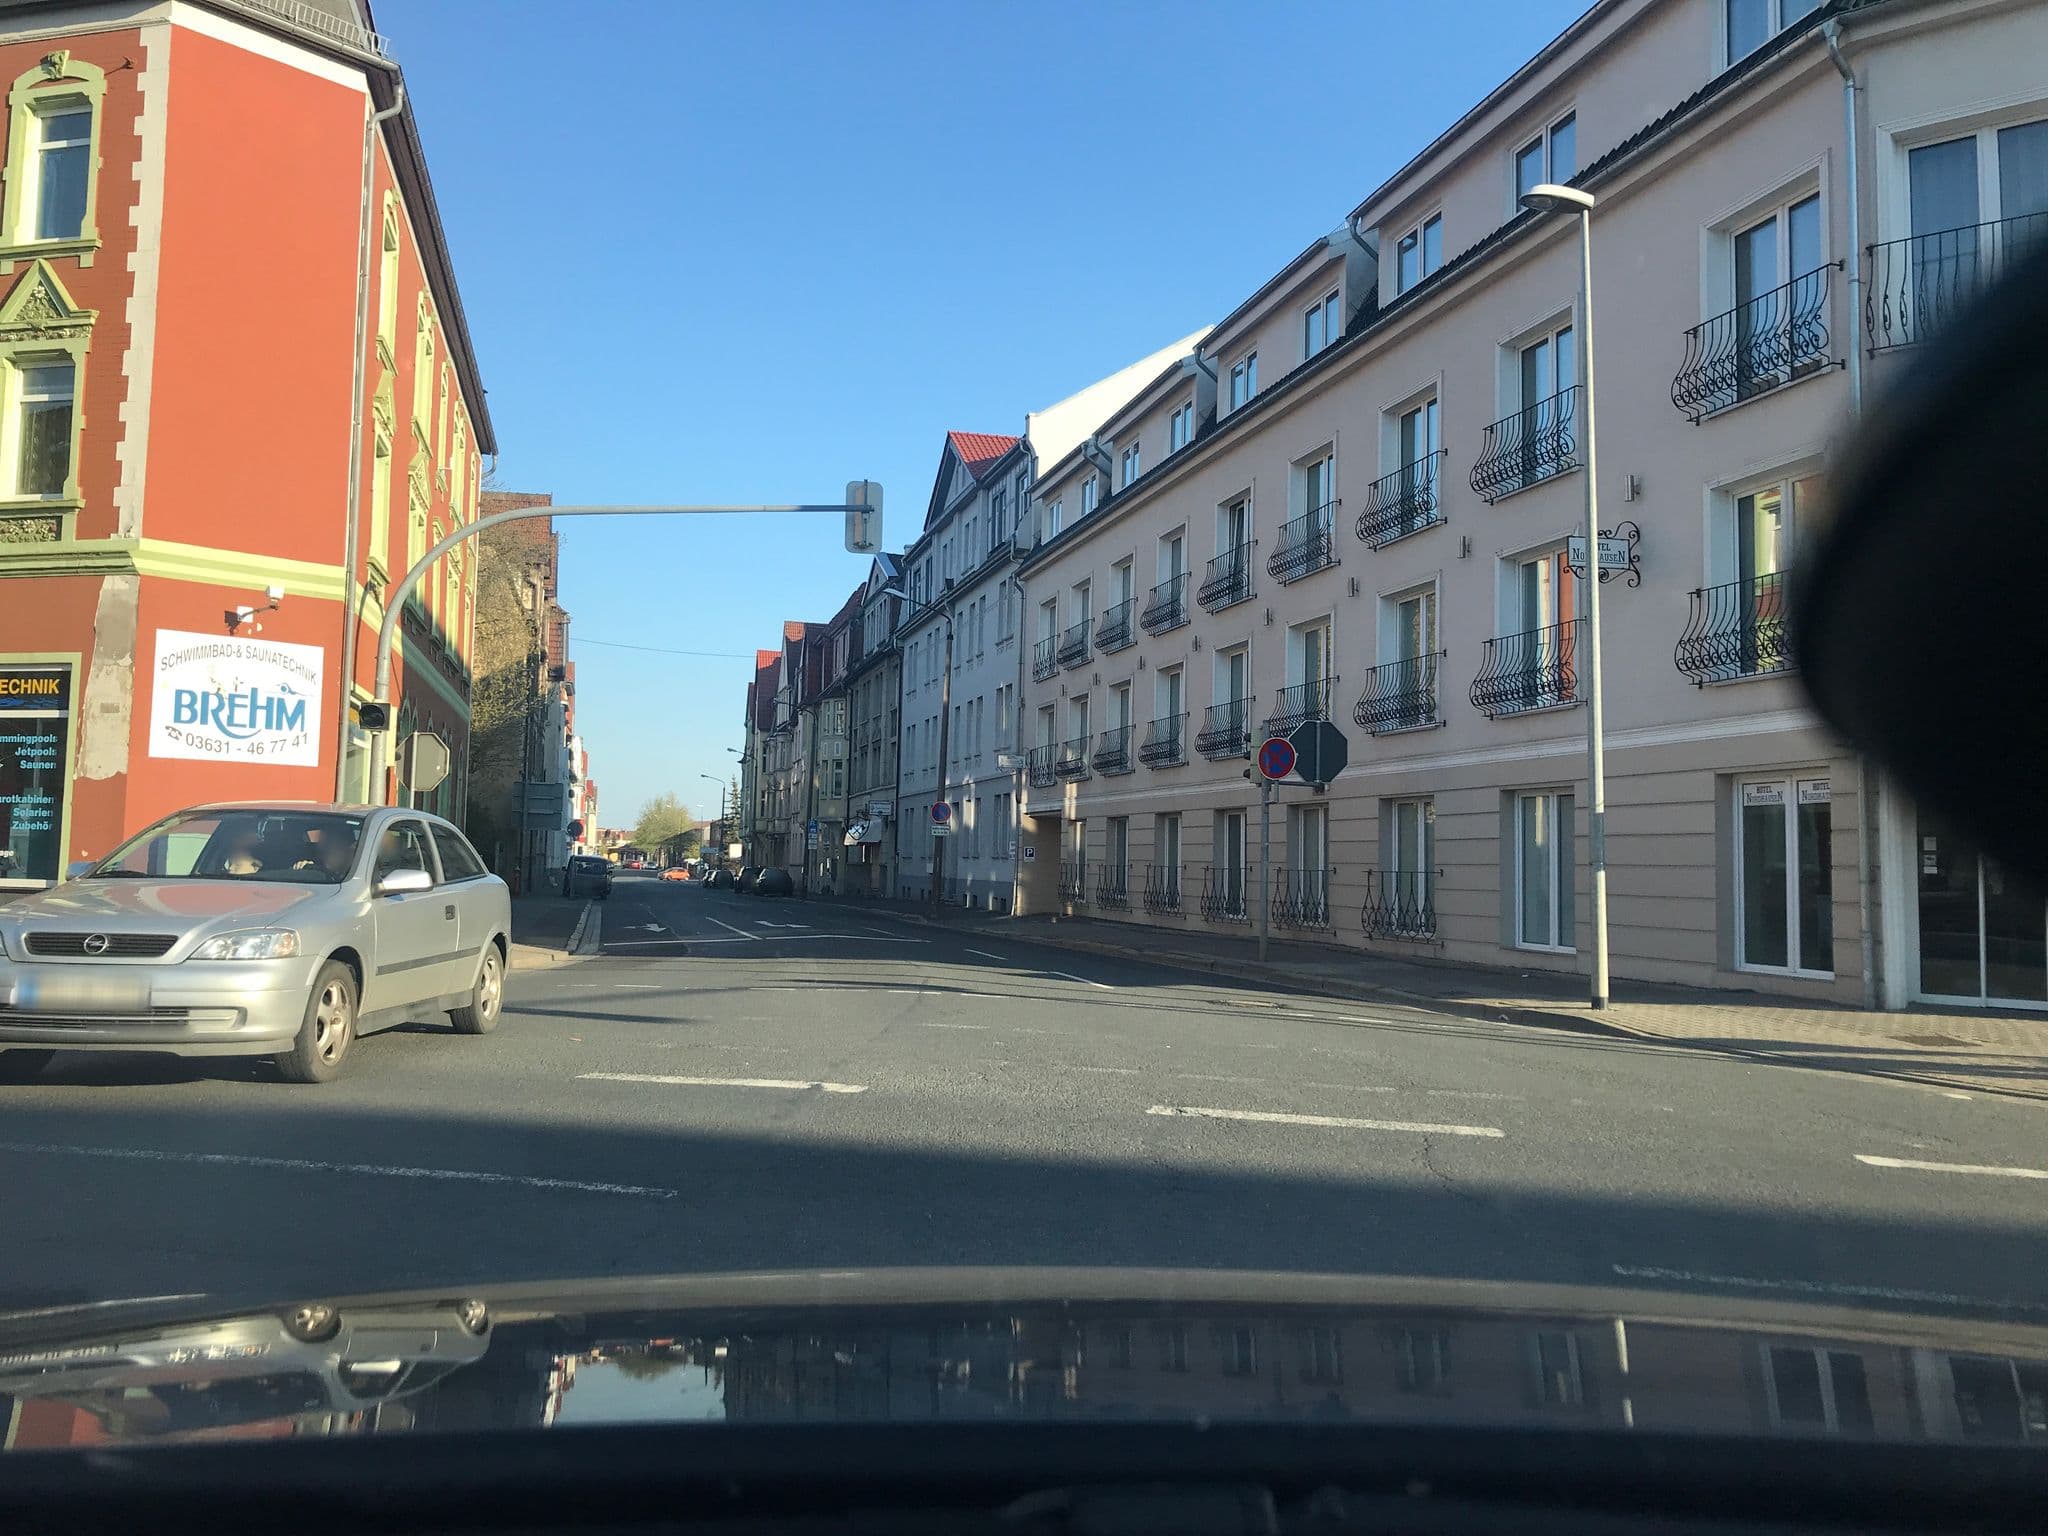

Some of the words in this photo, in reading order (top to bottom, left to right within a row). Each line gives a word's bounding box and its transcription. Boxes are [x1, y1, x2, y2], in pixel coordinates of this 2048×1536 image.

[1572, 548, 1626, 562] NOAUSEN
[246, 645, 317, 686] SAUNATECHNIK
[0, 678, 60, 694] ECHNIK
[173, 687, 306, 740] BREHM
[185, 732, 230, 754] 03631
[246, 742, 265, 755] 46
[270, 738, 287, 753] 77
[292, 732, 308, 748] 41
[15, 746, 57, 758] Jetpools
[19, 760, 57, 769] Saunen
[0, 794, 54, 804] rotkabinen
[13, 807, 54, 817] Solarien
[12, 820, 53, 830] Zubehör
